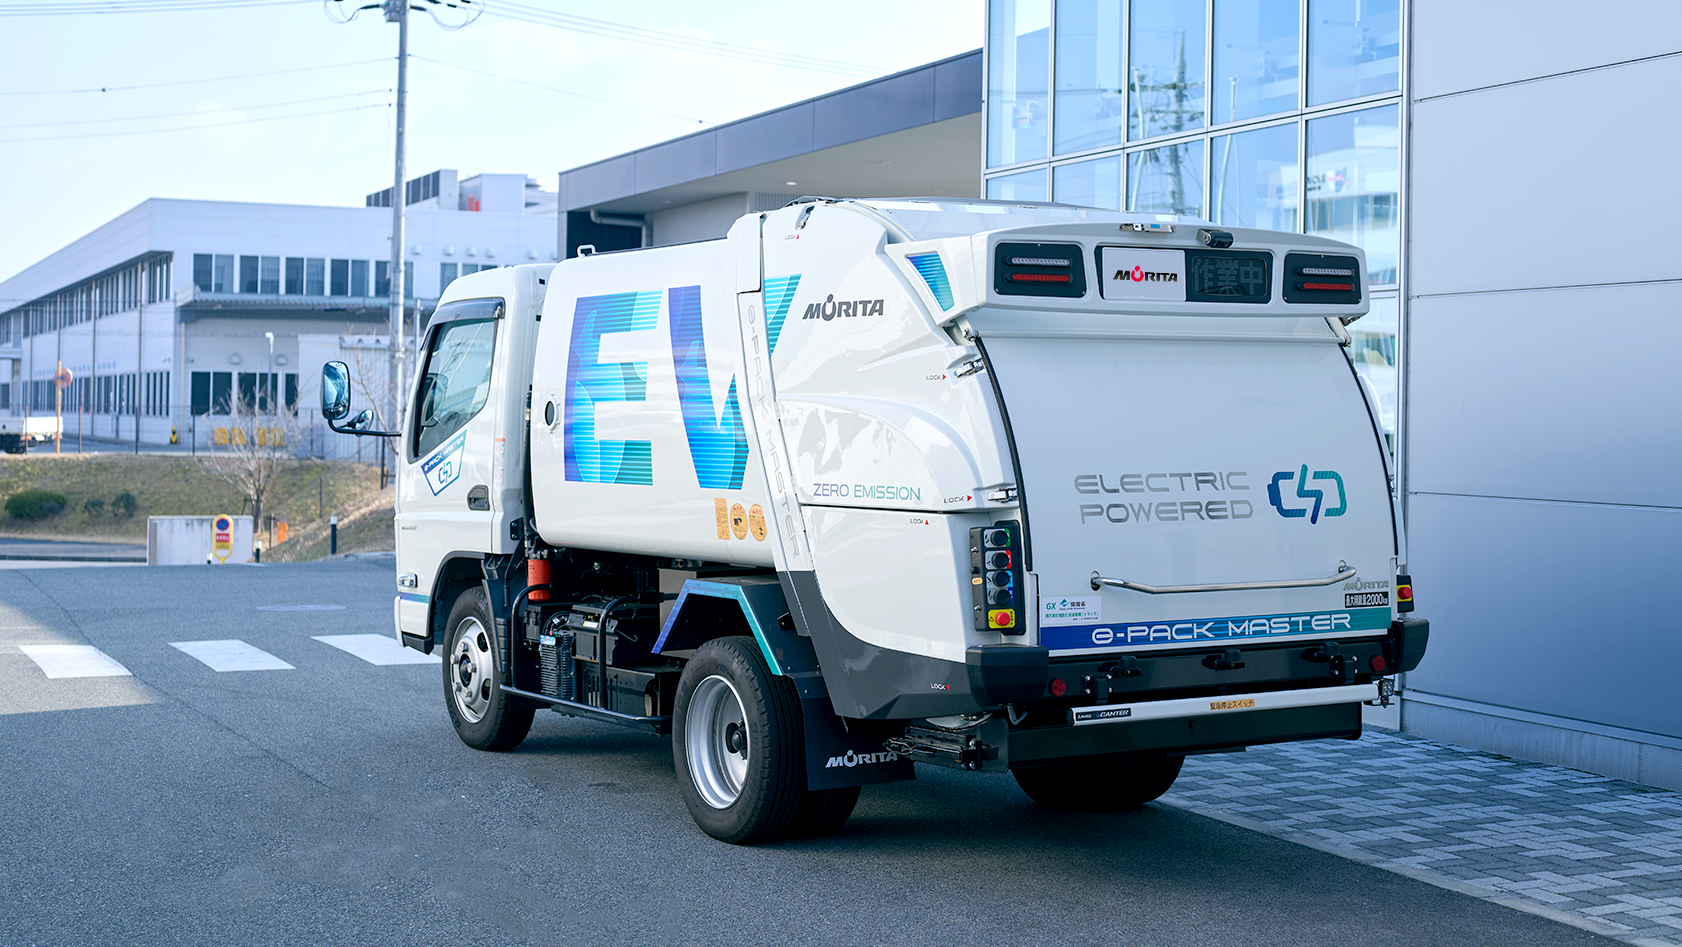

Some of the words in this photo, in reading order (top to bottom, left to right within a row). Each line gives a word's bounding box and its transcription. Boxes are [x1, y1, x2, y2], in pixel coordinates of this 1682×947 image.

[1112, 265, 1178, 283] MORITA
[1192, 259, 1263, 296] 作業中
[802, 293, 884, 321] MORITA
[813, 483, 850, 498] ZERO
[853, 484, 921, 501] EMISSION
[1074, 471, 1251, 495] ELECTRIC
[766, 428, 800, 559] MASTER
[943, 496, 965, 504] LOCK
[1079, 499, 1254, 525] POWERED
[1343, 576, 1389, 591] MORITA
[1046, 602, 1057, 610] GX
[1091, 622, 1215, 645] e-PACK
[1228, 613, 1351, 637] MASTER
[930, 682, 946, 690] LOCK
[825, 749, 898, 767] MORITA
